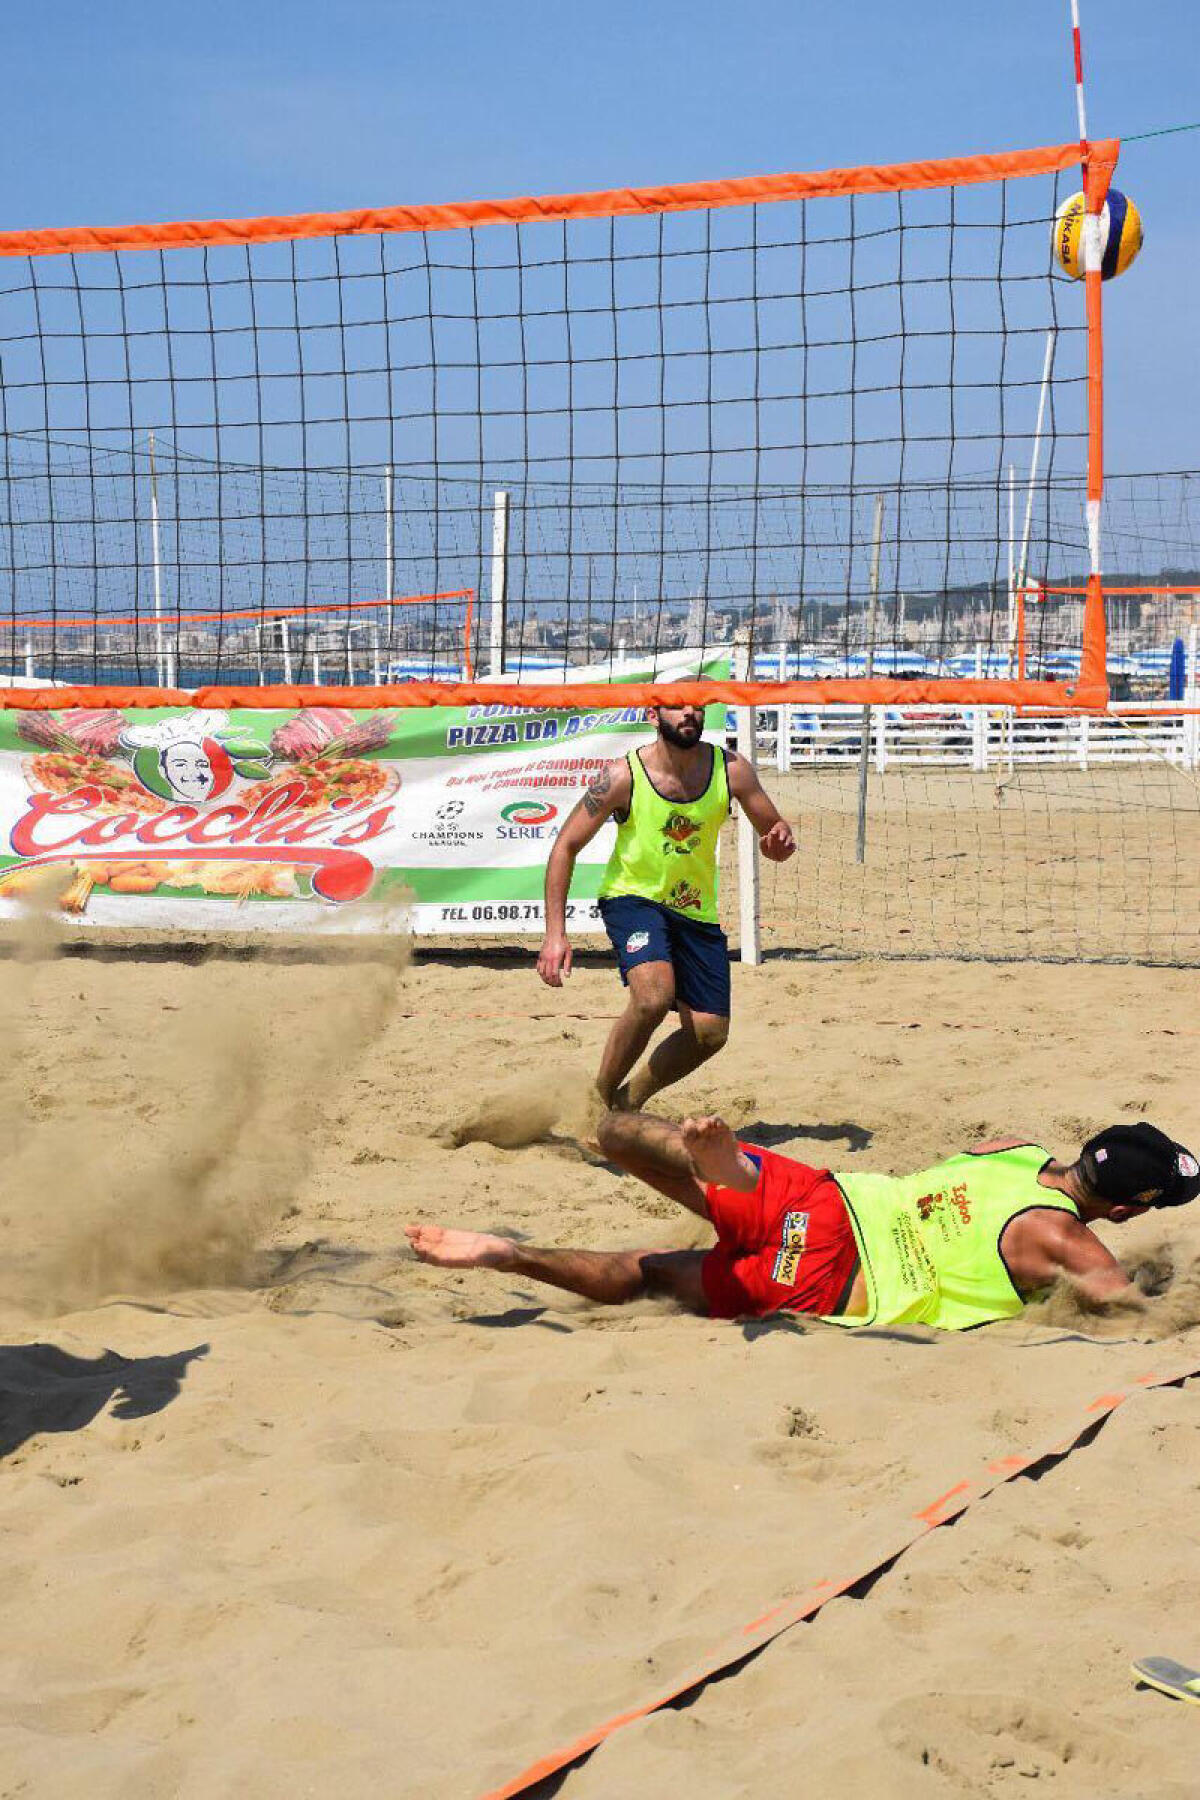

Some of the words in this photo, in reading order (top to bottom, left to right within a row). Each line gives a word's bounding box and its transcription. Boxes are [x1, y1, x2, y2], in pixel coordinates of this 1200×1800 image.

[447, 721, 519, 749] PIZZA
[524, 719, 559, 742] DA
[411, 831, 484, 840] CHAMPIONS
[496, 825, 545, 840] SERIE
[548, 826, 559, 839] A
